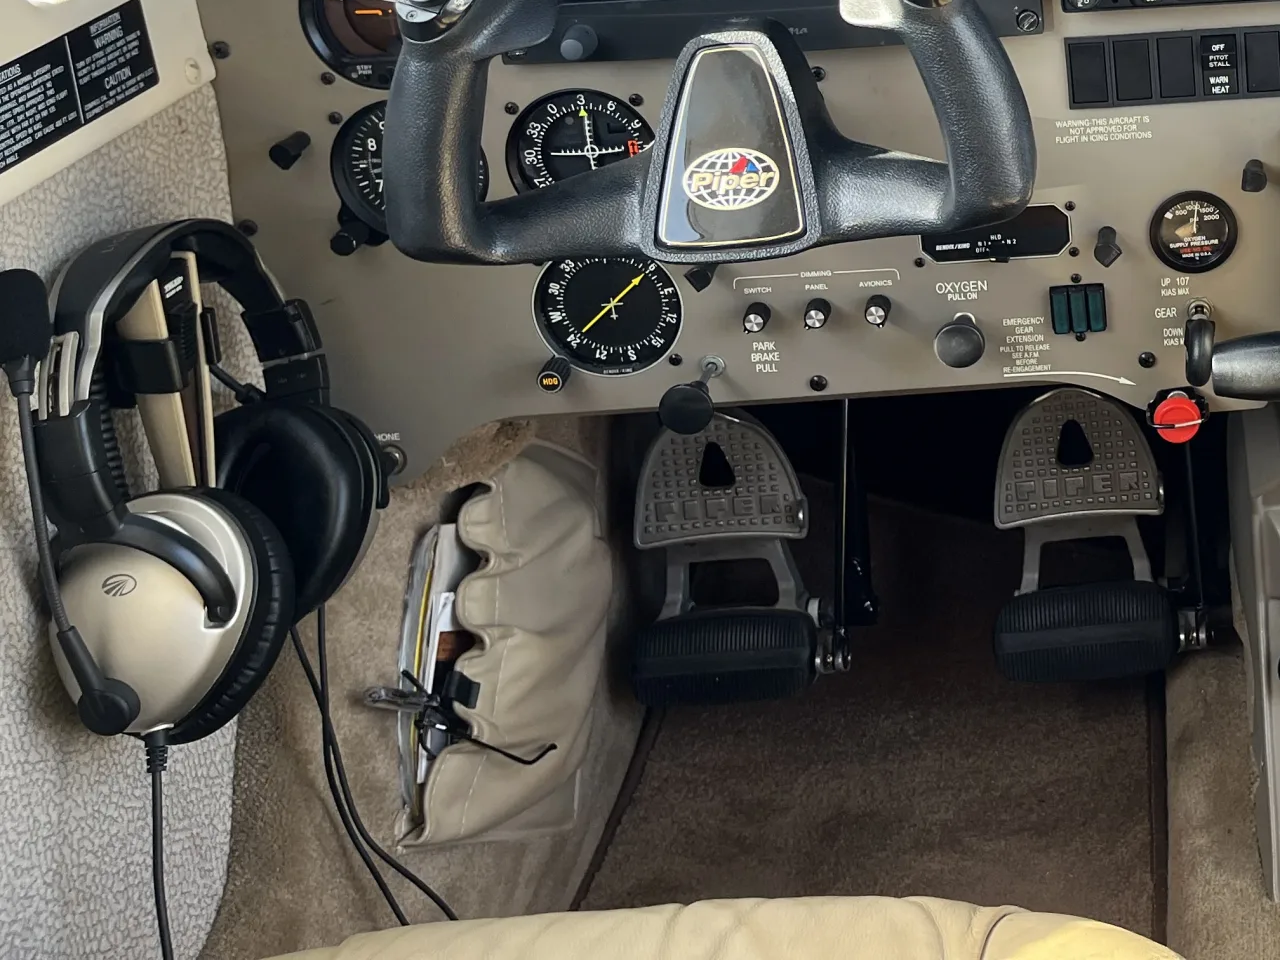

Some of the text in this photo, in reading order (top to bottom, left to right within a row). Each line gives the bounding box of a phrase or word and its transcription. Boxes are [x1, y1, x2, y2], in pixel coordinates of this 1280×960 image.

[93, 25, 124, 49] WARNING
[1211, 43, 1226, 51] OFF
[104, 65, 132, 89] CAUTION
[1209, 76, 1229, 84] WARN
[1211, 85, 1230, 94] HEAT
[576, 94, 586, 105] 3
[547, 103, 558, 114] 0
[526, 122, 541, 138] 33
[1069, 124, 1137, 135] NOT APPROVED FOR
[1055, 131, 1153, 144] FLIGHT IN ICING CONDITIONS
[367, 138, 377, 151] 8
[524, 149, 538, 165] 30
[690, 170, 776, 195] Piper
[800, 270, 832, 278] DIMMING
[859, 279, 893, 288] AVIONICS
[1160, 276, 1190, 287] UP 107
[548, 282, 560, 295] 30
[935, 280, 988, 294] OXYGEN
[1161, 287, 1190, 296] KIAS MAX
[947, 292, 978, 301] PULL ON
[1154, 307, 1177, 318] GEAR
[1002, 316, 1045, 326] EMERGENCY
[1015, 326, 1034, 334] GEAR
[1163, 328, 1183, 337] DOWN
[566, 333, 581, 349] 24
[1006, 334, 1044, 343] EXTENSION
[752, 341, 776, 351] PARK
[751, 352, 780, 362] BRAKE
[756, 363, 778, 372] PULL
[542, 377, 559, 385] HDG
